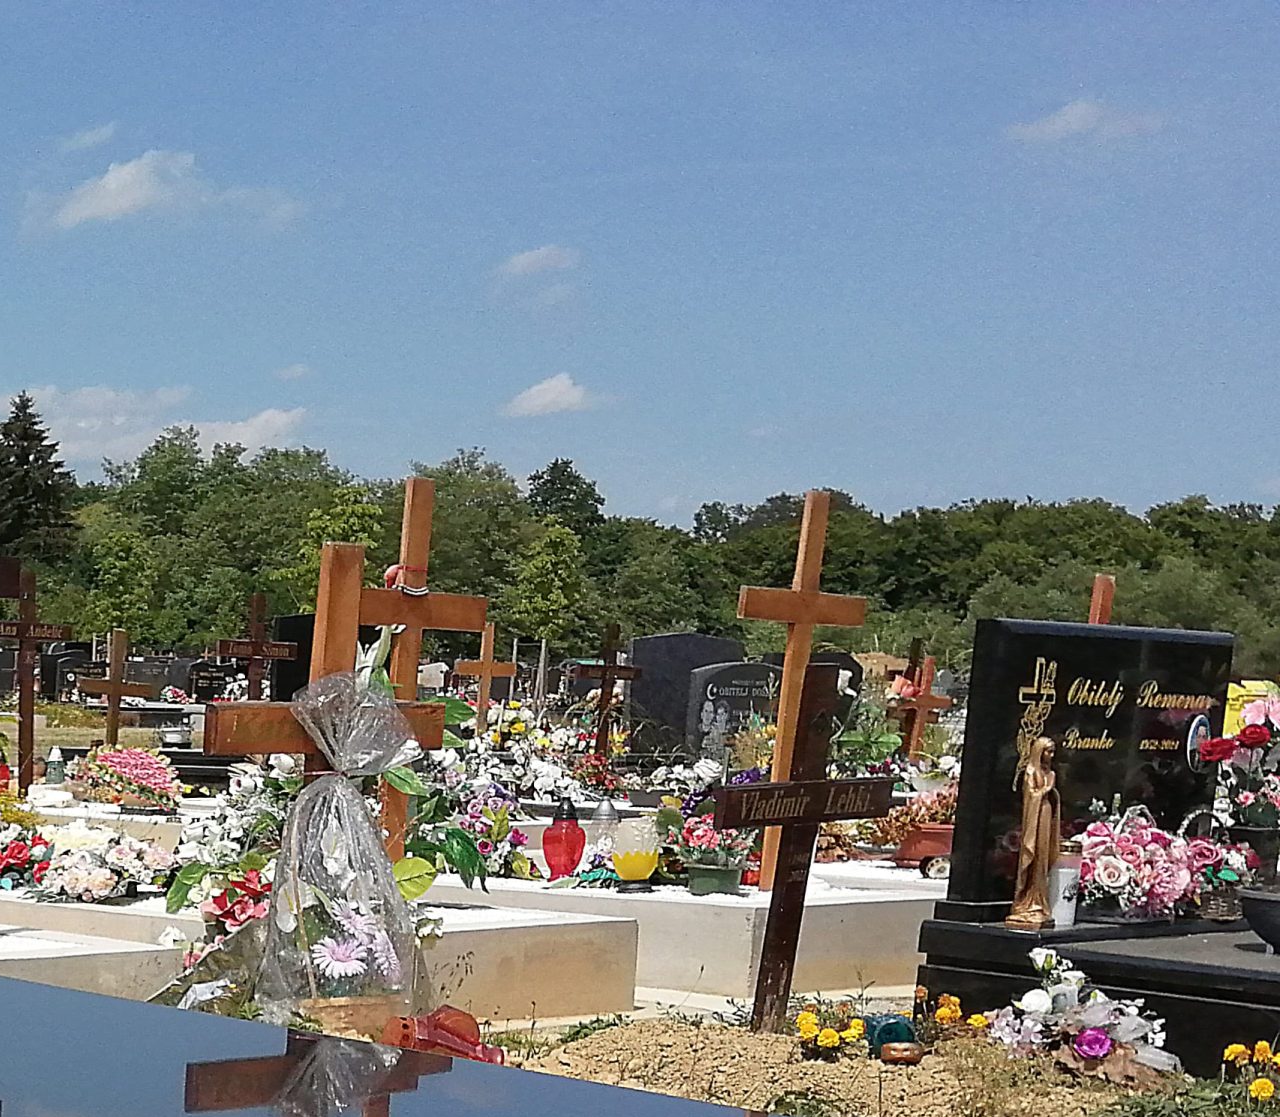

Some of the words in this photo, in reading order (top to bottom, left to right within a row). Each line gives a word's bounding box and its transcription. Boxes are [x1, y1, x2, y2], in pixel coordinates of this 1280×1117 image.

[1067, 676, 1125, 719] Obitelj
[1062, 727, 1116, 750] Branko
[740, 788, 810, 821] Vladimir
